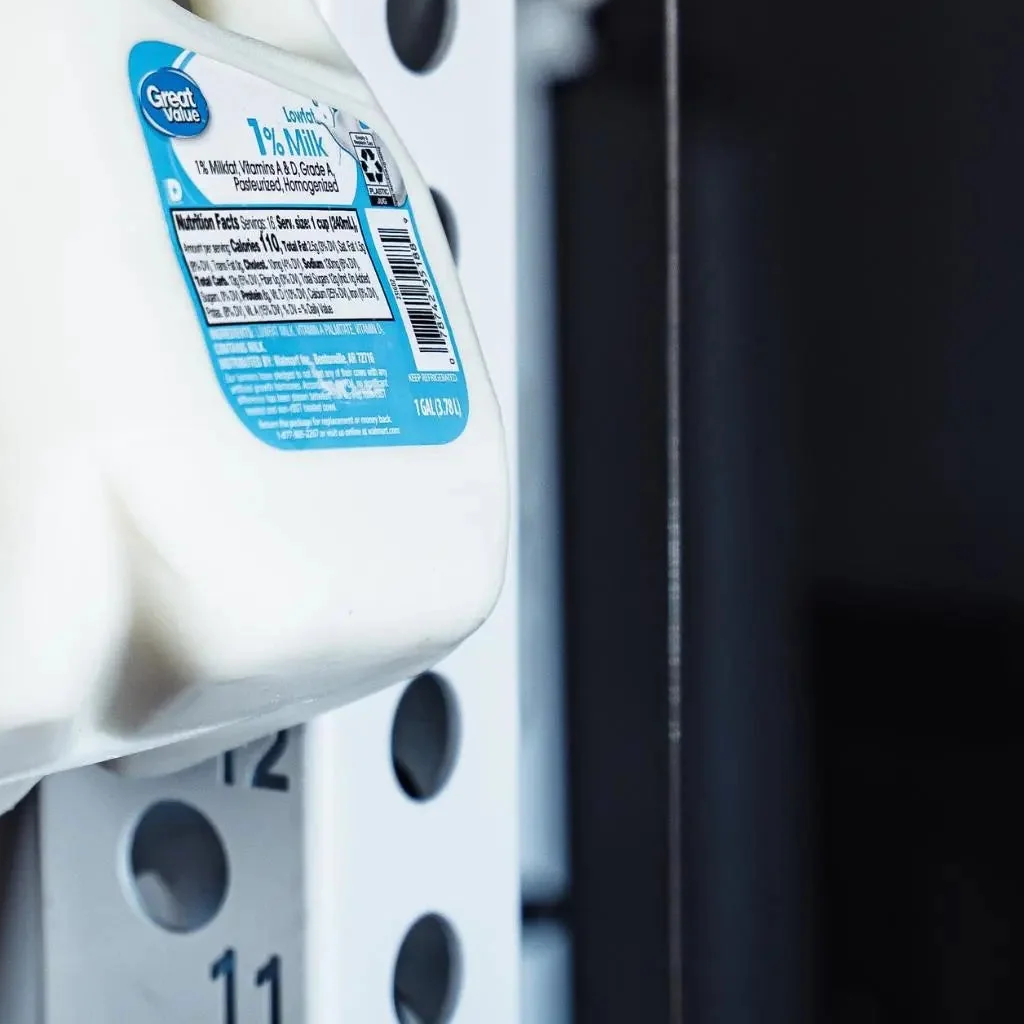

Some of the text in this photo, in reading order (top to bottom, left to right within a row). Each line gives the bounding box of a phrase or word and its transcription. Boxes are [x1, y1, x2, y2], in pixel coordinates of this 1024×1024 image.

[147, 85, 197, 108] Great
[163, 106, 200, 122] Value
[283, 106, 317, 123] Lowfat
[247, 118, 328, 156] 1% Milk
[195, 160, 209, 175] 1%
[209, 160, 241, 176] Milkfat,
[239, 160, 275, 175] Vitamins
[276, 161, 284, 175] A
[284, 161, 290, 175] &
[290, 161, 300, 177] D,
[300, 162, 325, 176] Grade
[234, 177, 339, 196] Pasteurized, Homogenized
[176, 213, 215, 230] Nutrition
[215, 213, 240, 230] Facts
[276, 215, 295, 229] Serv.
[311, 216, 316, 229] 1
[316, 218, 329, 232] cup
[230, 238, 261, 252] Calories
[282, 240, 296, 252] Total
[297, 240, 308, 252] Fat
[302, 257, 325, 269] Sodium
[410, 243, 430, 287] 35188
[414, 397, 462, 418] 1 GAL (3.78 L)
[209, 944, 282, 1024] 11
